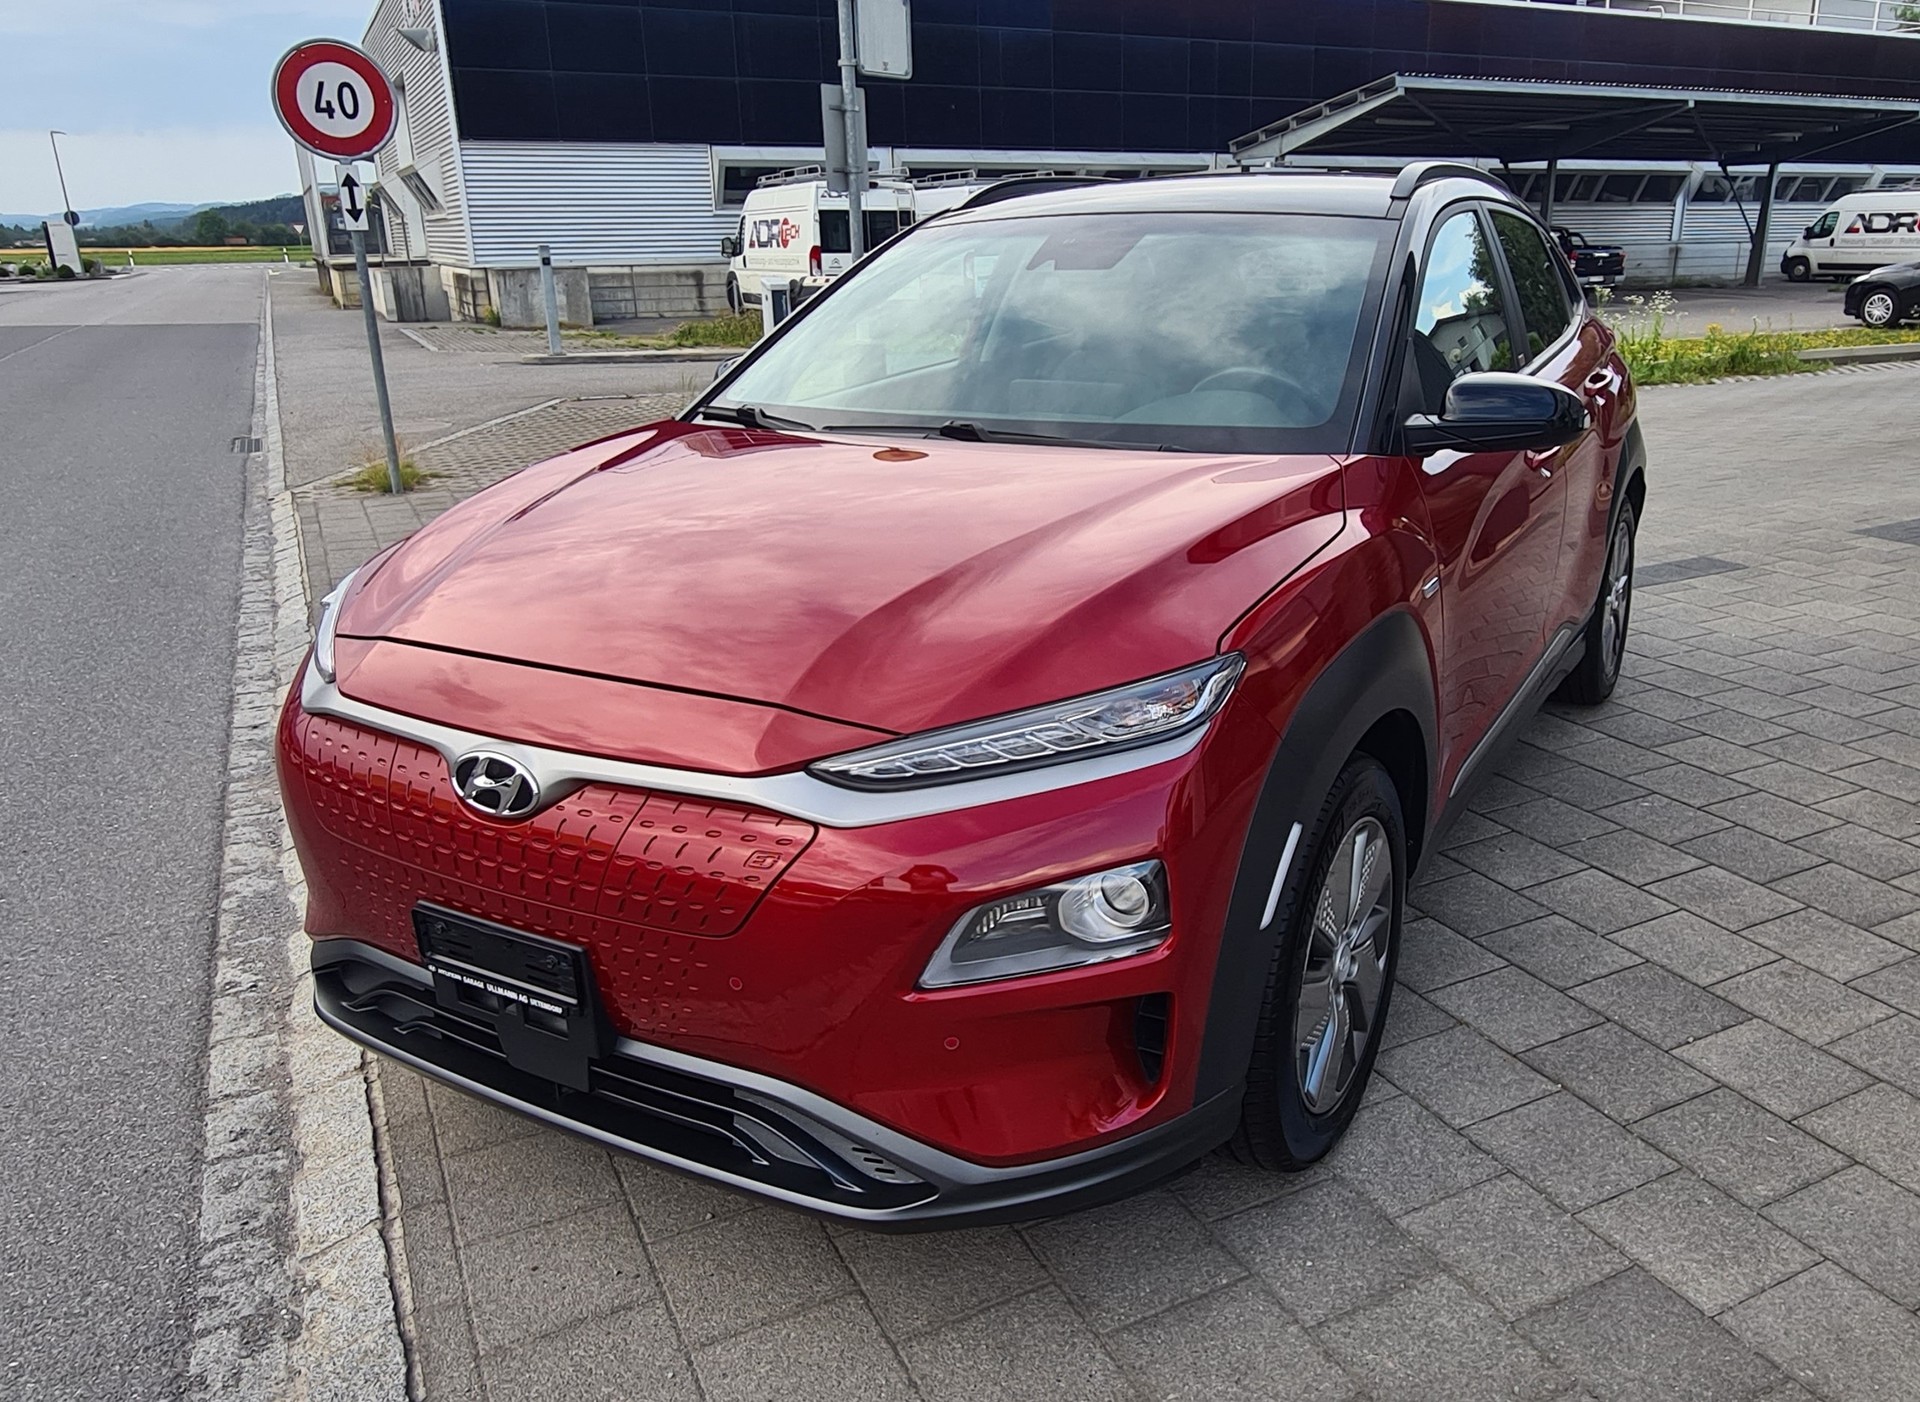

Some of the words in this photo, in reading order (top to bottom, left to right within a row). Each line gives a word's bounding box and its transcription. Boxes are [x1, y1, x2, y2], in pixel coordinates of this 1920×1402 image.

[314, 81, 360, 120] 40
[462, 976, 485, 989] GARAGE
[486, 983, 518, 1000] ULLMANN
[518, 993, 529, 1004] AG
